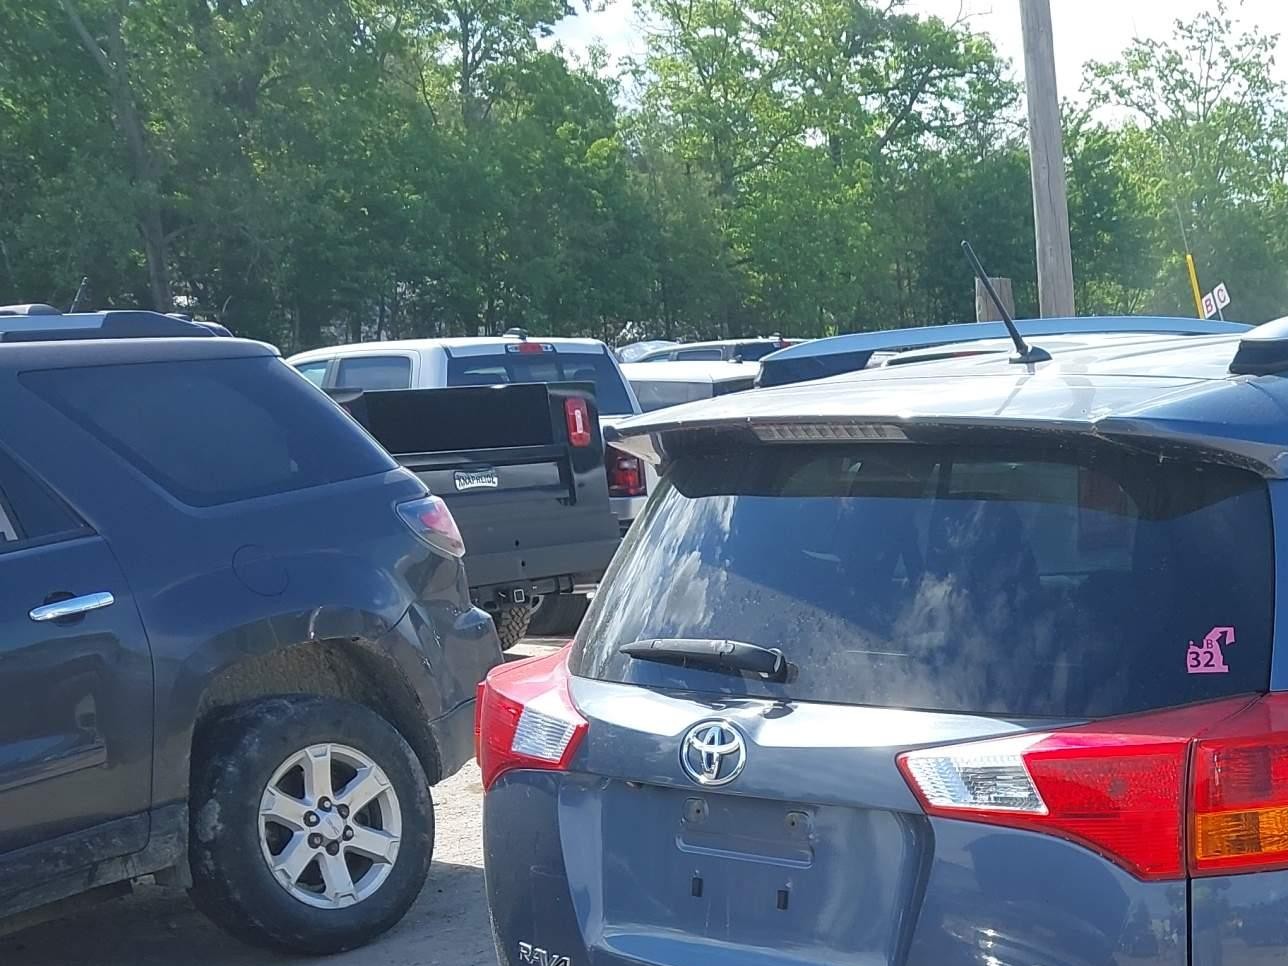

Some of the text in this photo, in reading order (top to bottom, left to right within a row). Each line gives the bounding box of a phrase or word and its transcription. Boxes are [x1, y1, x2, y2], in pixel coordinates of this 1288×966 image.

[1204, 298, 1213, 314] B
[1206, 639, 1214, 649] B
[1189, 650, 1216, 668] 32
